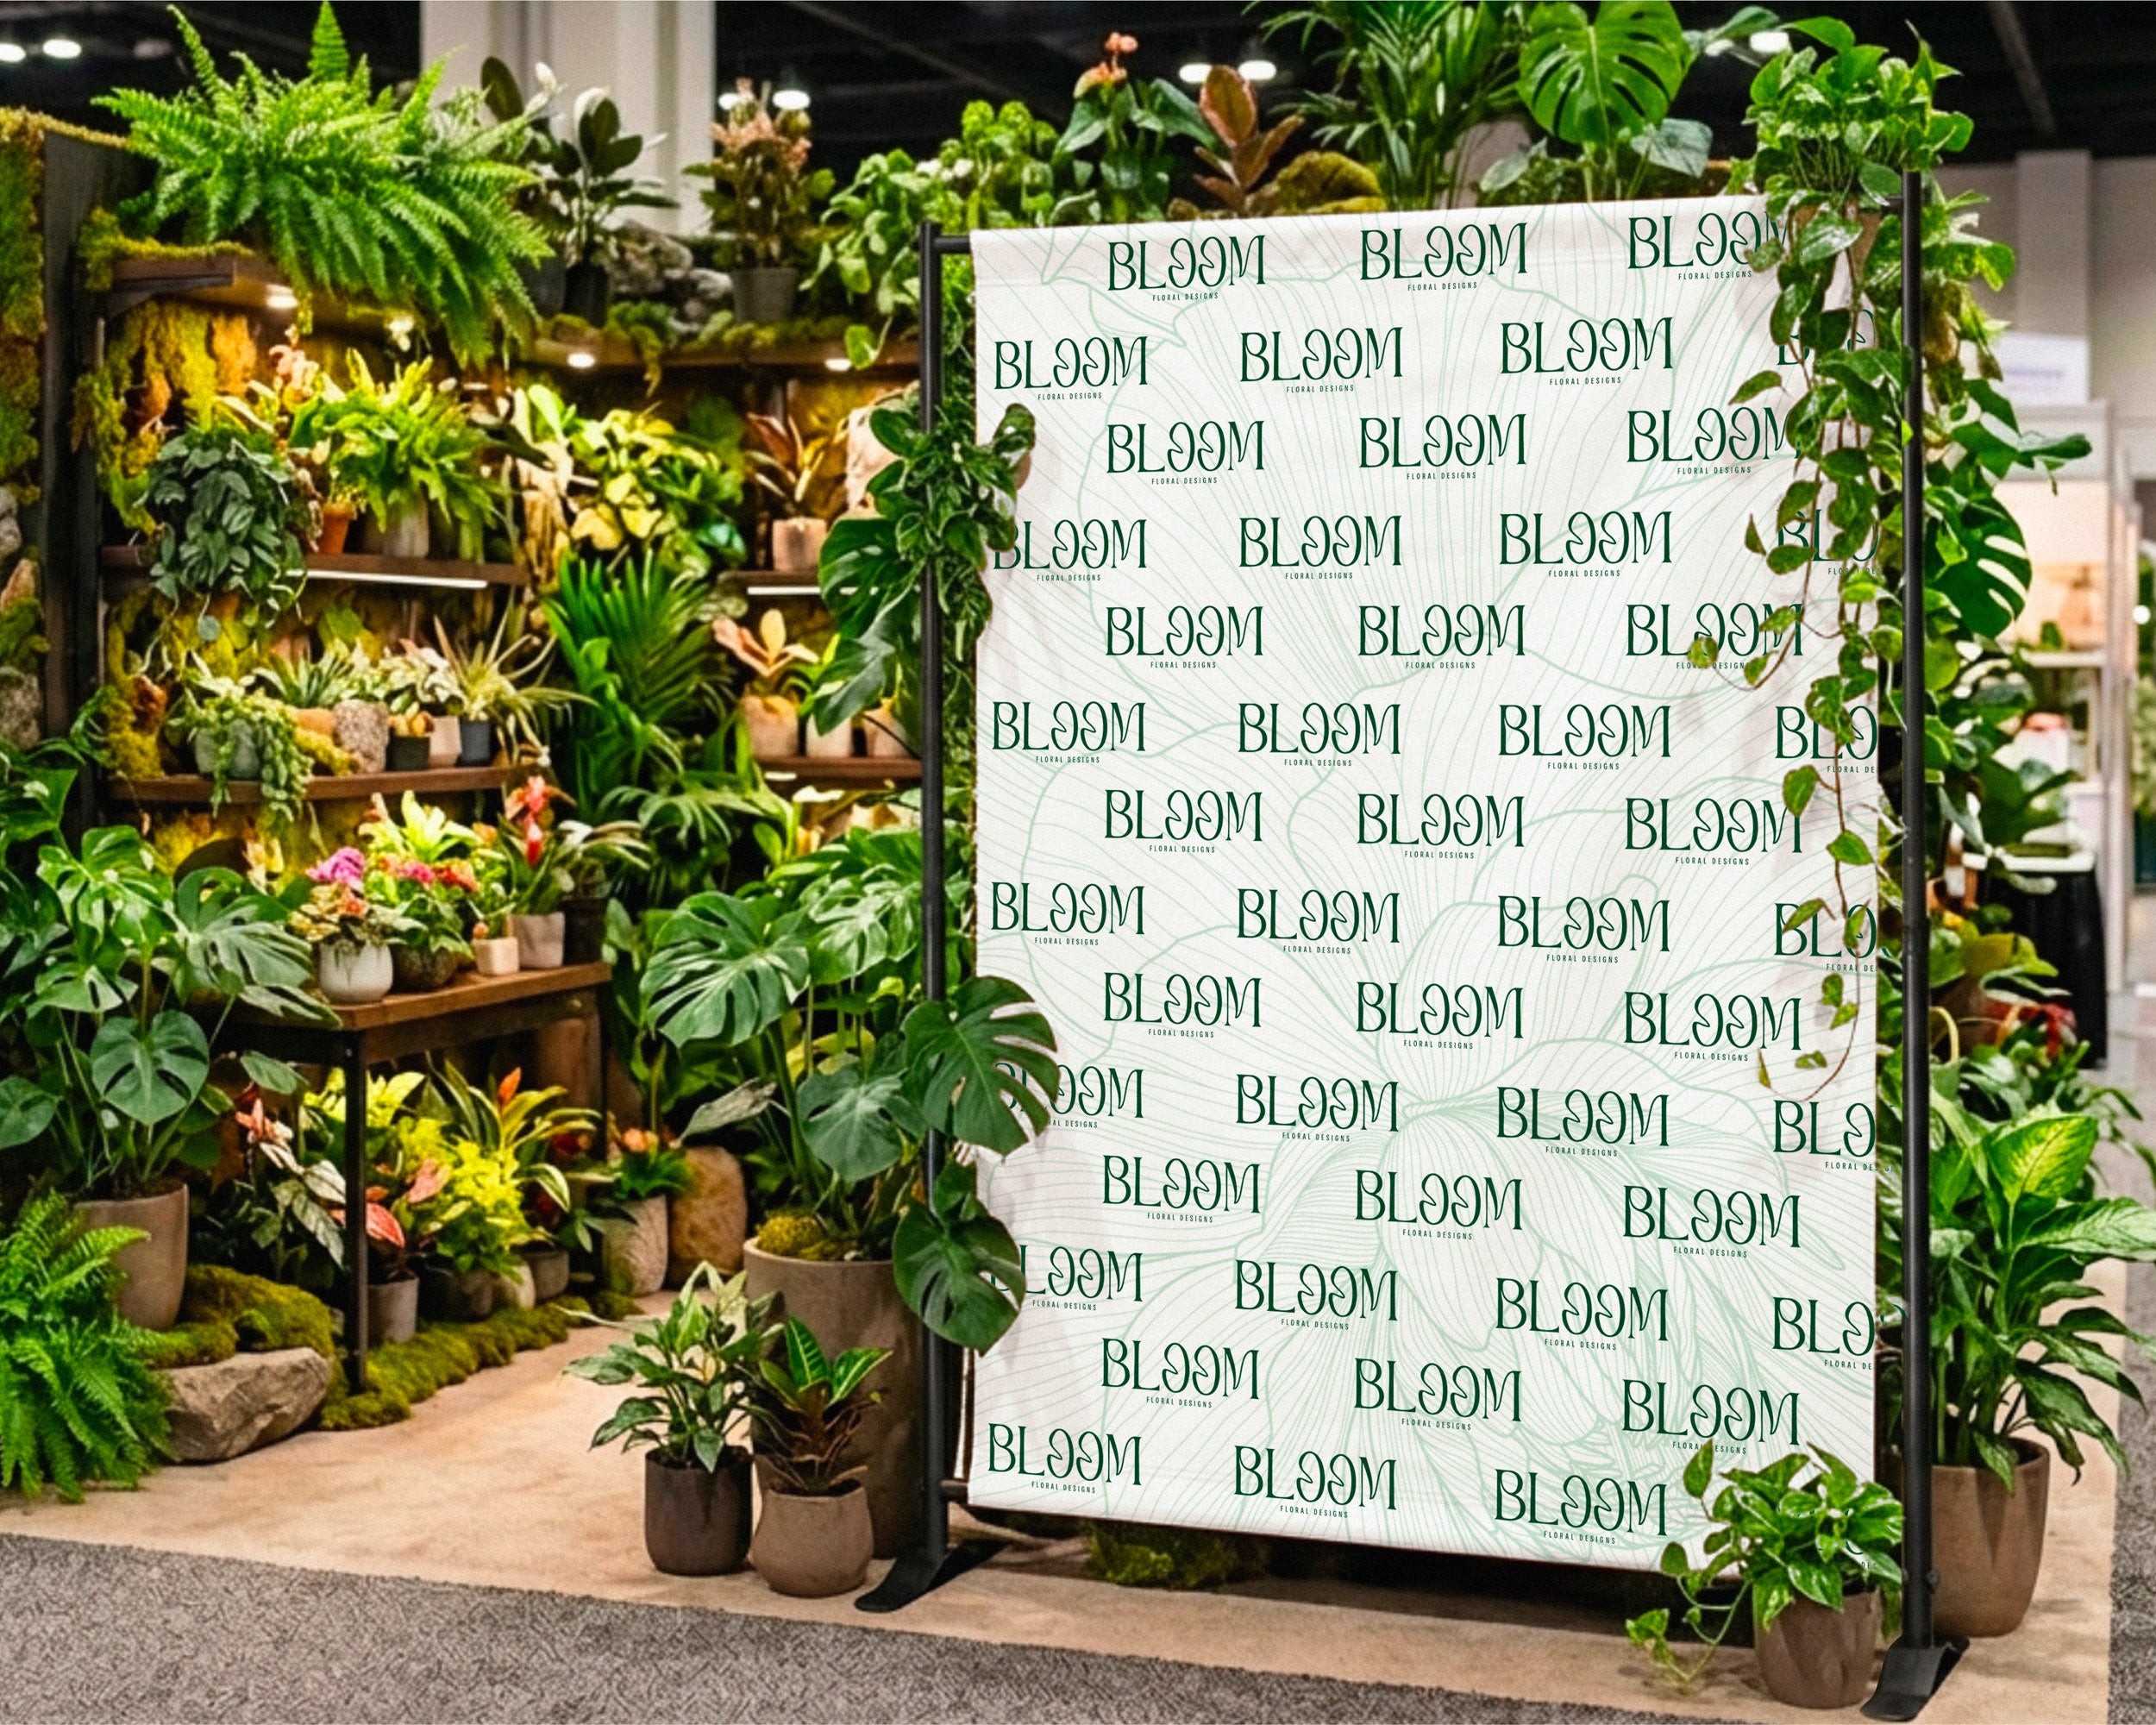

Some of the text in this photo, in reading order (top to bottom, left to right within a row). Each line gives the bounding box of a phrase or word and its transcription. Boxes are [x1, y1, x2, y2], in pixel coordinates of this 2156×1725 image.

[1107, 235, 1266, 292] BLOOM
[1360, 222, 1527, 280] BLOOM
[1678, 270, 1752, 280] FLORAL DESIGNS
[1153, 292, 1219, 302] FLORAL DESIGNS
[1407, 281, 1477, 292] FLORAL DESIGNS
[994, 336, 1148, 390] BLOOM
[1240, 326, 1403, 382] BLOOM
[1500, 317, 1674, 374] BLOOM
[1070, 392, 1102, 400] DESIGNS
[1320, 384, 1354, 392] DESIGNS
[1585, 376, 1620, 385] DESIGNS
[1106, 420, 1264, 474] BLOOM
[1359, 413, 1526, 468] BLOOM
[1184, 476, 1218, 485] DESIGNS
[1441, 471, 1476, 480] DESIGNS
[1714, 466, 1751, 474] DESIGNS
[1238, 515, 1402, 568] BLOOM
[1499, 511, 1672, 565] BLOOM
[1106, 605, 1263, 656] BLOOM
[1357, 604, 1526, 657] BLOOM
[992, 700, 1146, 752] BLOOM
[1238, 702, 1401, 755] BLOOM
[1498, 704, 1671, 758] BLOOM
[1827, 765, 1859, 774] FLORAL
[1104, 789, 1263, 842] BLOOM
[1357, 793, 1525, 848] BLOOM
[1625, 797, 1802, 854] BLOOM
[1181, 845, 1215, 854] DESIGNS
[1712, 857, 1749, 866] DESIGNS
[991, 881, 1145, 935] BLOOM
[1237, 888, 1400, 944] BLOOM
[1498, 895, 1670, 952] BLOOM
[1774, 902, 1877, 959] BLO
[1067, 938, 1099, 946] DESIGNS
[1317, 946, 1351, 955] DESIGNS
[1547, 954, 1619, 963] FLORAL DESIGNS
[1826, 963, 1858, 972] FLORAL
[1103, 972, 1262, 1028] BLOOM
[1356, 982, 1524, 1039] BLOOM
[1624, 991, 1802, 1051] BLOOM
[1181, 1030, 1214, 1038] DESIGNS
[1438, 1041, 1473, 1050] DESIGNS
[1711, 1052, 1748, 1062] DESIGNS
[1065, 1120, 1097, 1129] DESIGNS
[1236, 1074, 1399, 1132] BLOOM
[1496, 1086, 1670, 1147] BLOOM
[1282, 1132, 1350, 1143] FLORAL DESIGNS
[1545, 1145, 1617, 1157] FLORAL DESIGNS
[1102, 1155, 1261, 1214] BLOOM
[1825, 1161, 1858, 1170] FLORAL
[1180, 1214, 1213, 1223] DESIGNS
[1355, 1169, 1523, 1231] BLOOM
[1623, 1185, 1801, 1248] BLOOM
[1402, 1228, 1472, 1240] FLORAL DESIGNS
[1674, 1245, 1747, 1258] FLORAL DESIGNS
[990, 1245, 1143, 1302] LOOM
[1234, 1259, 1398, 1321] BLOOM
[1032, 1299, 1096, 1311] FLORAL DESIGNS
[1281, 1318, 1348, 1331] FLORAL DESIGNS
[1495, 1277, 1669, 1342] BLOOM
[1772, 1296, 1875, 1357] BLO
[1101, 1338, 1259, 1400] BLOOM
[1545, 1338, 1616, 1351] FLORAL DESIGNS
[1824, 1359, 1857, 1369] FLORAL
[1147, 1396, 1213, 1408] FLORAL DESIGNS
[1354, 1358, 1522, 1422] BLOOM
[1621, 1378, 1800, 1446] BLOOM
[1401, 1417, 1471, 1431] FLORAL DESIGNS
[1714, 1445, 1746, 1455] ESIGNS
[987, 1422, 1142, 1486] BLOOM
[1234, 1445, 1397, 1510] BLOOM
[1031, 1481, 1095, 1494] FLORAL DESIGNS
[1281, 1505, 1348, 1519] FLORAL DESIGNS
[1495, 1468, 1667, 1537] BLOOM
[1544, 1530, 1615, 1545] FLORAL DESIGNS
